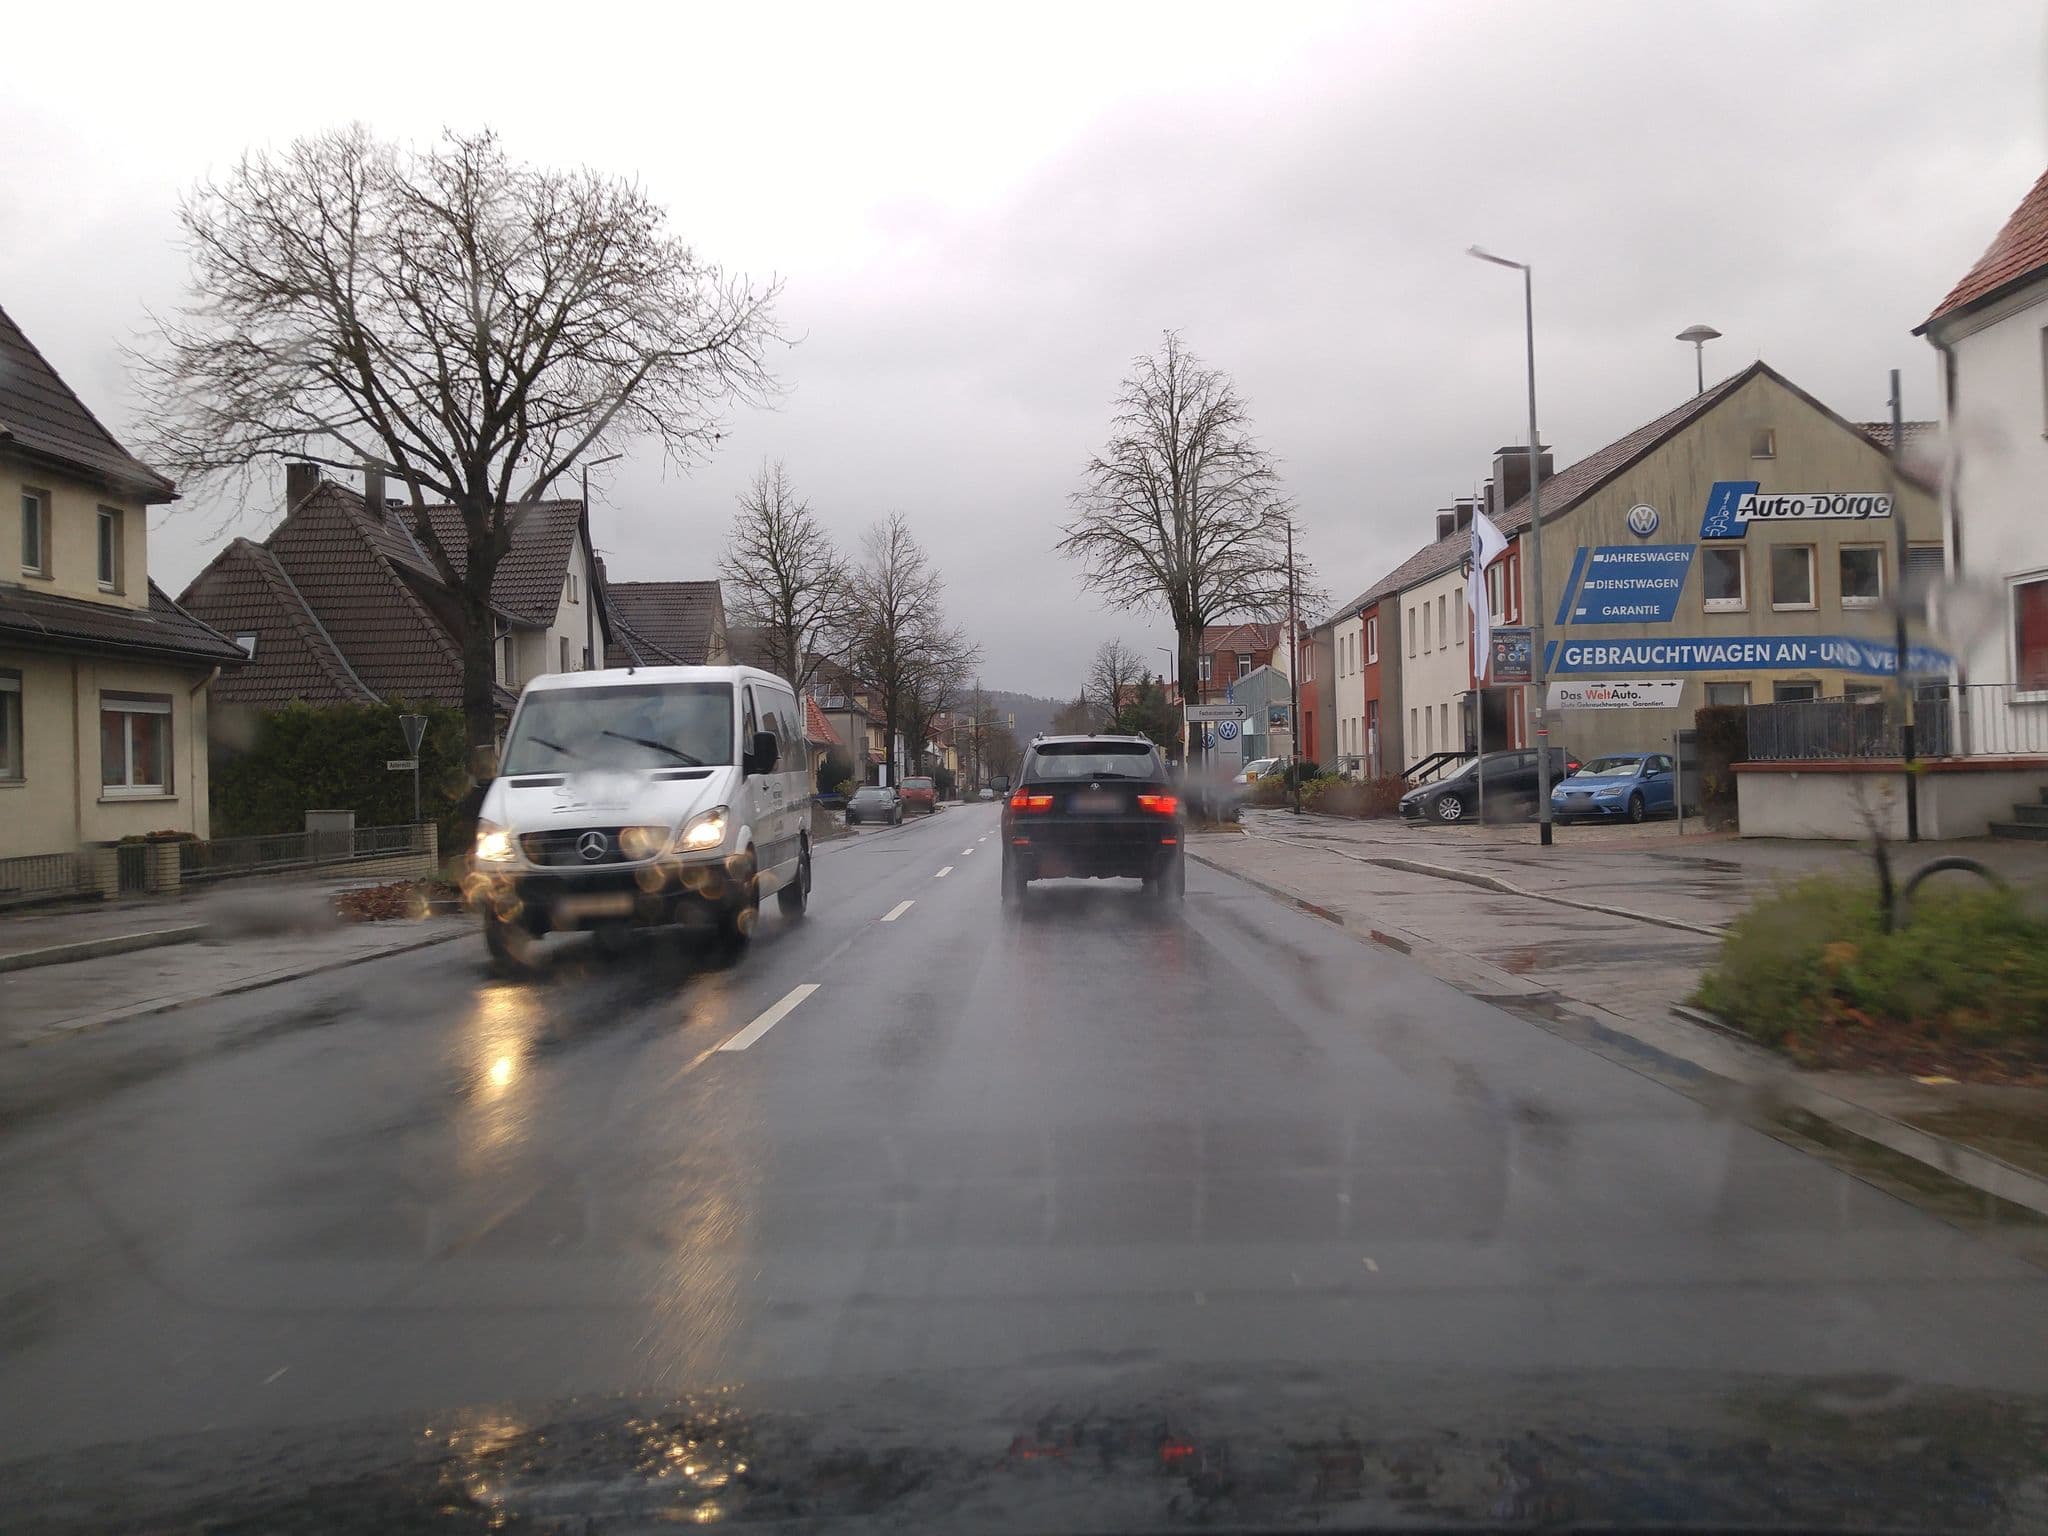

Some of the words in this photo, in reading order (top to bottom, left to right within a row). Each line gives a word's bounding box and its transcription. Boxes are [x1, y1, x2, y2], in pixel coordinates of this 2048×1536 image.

[1739, 494, 1889, 520] Auto-Dörge
[1603, 552, 1690, 563] JAHRESWAGEN
[1596, 578, 1679, 590] DIENSTWAGEN
[1602, 605, 1661, 616] GARANTIE
[1565, 643, 1770, 666] GEBRAUCHTWAGEN
[1560, 690, 1582, 700] Das
[1585, 688, 1641, 701] WeltAuto.
